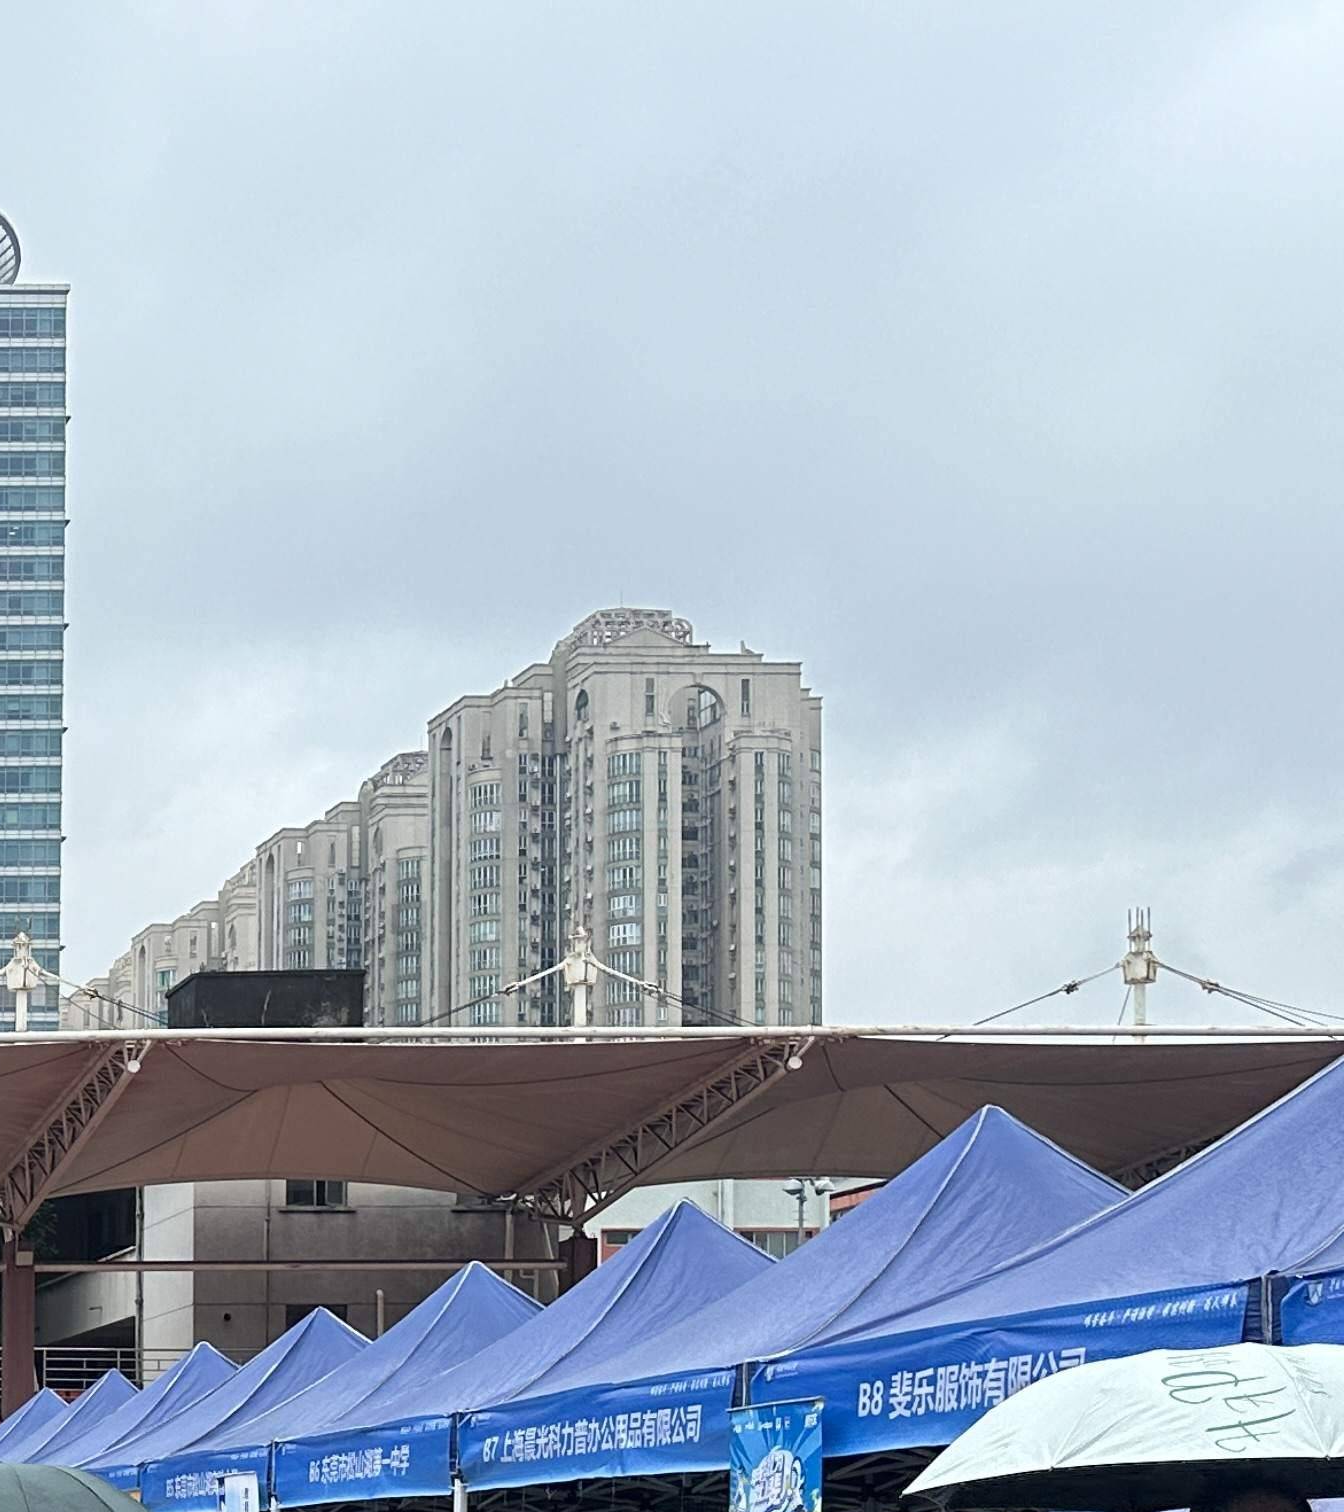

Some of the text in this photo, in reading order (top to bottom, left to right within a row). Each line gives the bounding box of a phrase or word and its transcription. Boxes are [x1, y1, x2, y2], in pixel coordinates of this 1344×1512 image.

[858, 1379, 884, 1418] B8
[483, 1436, 499, 1463] B7
[500, 1404, 703, 1463] 上海晨光科力普办公用品有限公司
